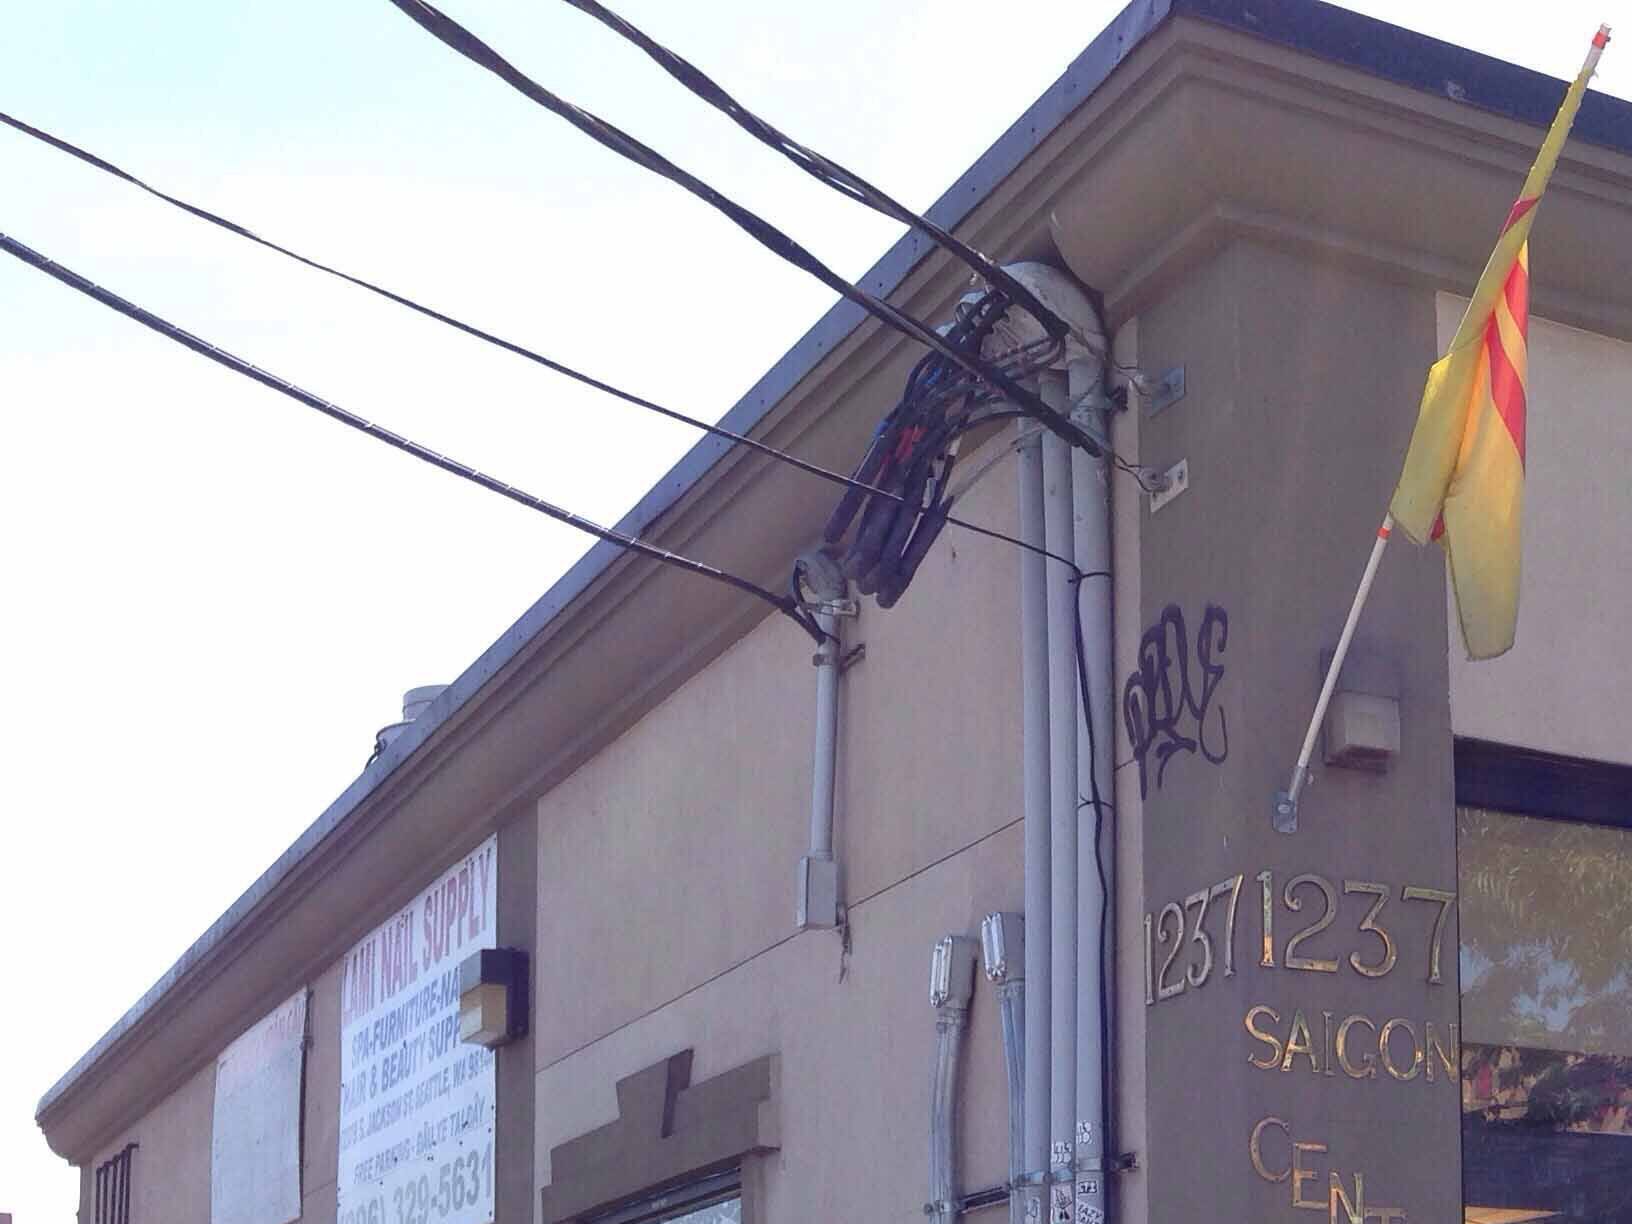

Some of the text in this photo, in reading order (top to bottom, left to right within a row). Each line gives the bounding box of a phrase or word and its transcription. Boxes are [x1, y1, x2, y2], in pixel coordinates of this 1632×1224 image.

[381, 910, 418, 1003] NAIL
[423, 847, 491, 972] SUPPLY
[1143, 873, 1245, 1006] 1237
[1255, 870, 1458, 985] 1237
[381, 1031, 426, 1094] BEAUTY
[1243, 1005, 1460, 1082] SAIGON
